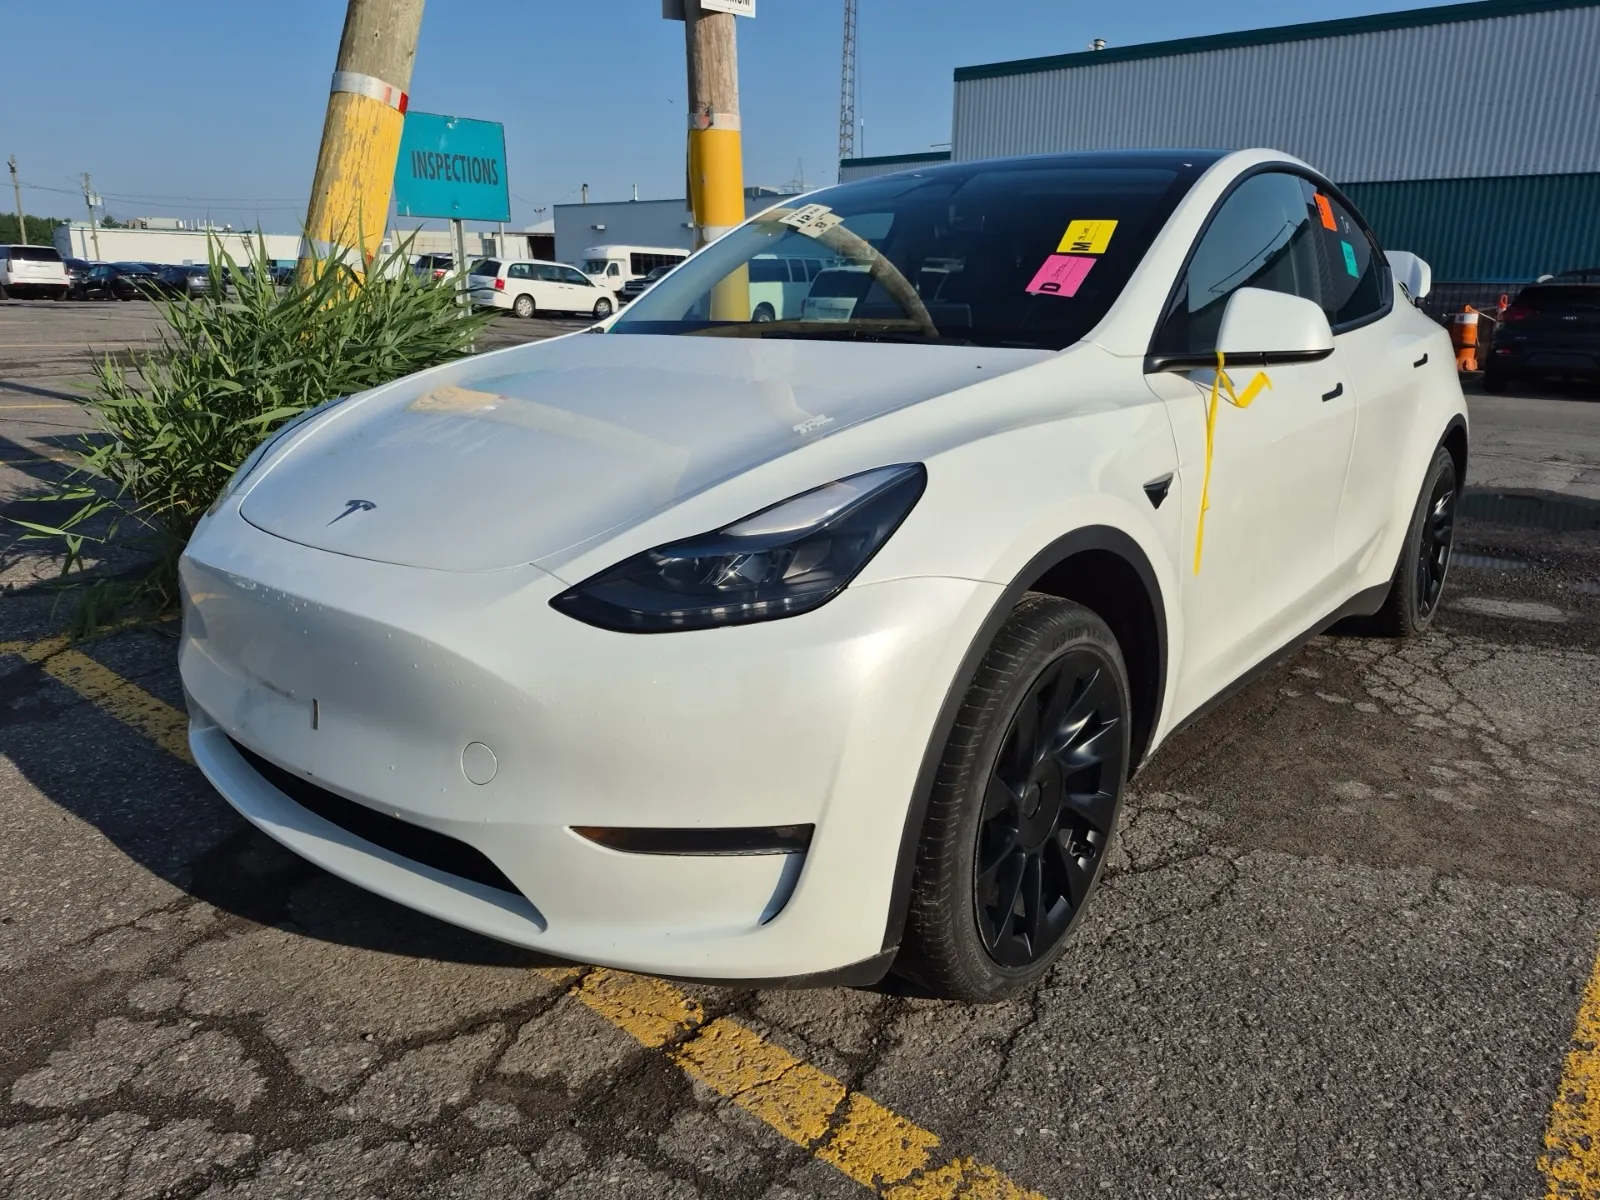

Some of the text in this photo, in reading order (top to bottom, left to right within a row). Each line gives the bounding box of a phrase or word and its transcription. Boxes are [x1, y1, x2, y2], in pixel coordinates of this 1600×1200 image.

[412, 151, 498, 185] INSPECTIONS
[1070, 242, 1092, 251] M
[1039, 282, 1061, 292] D
